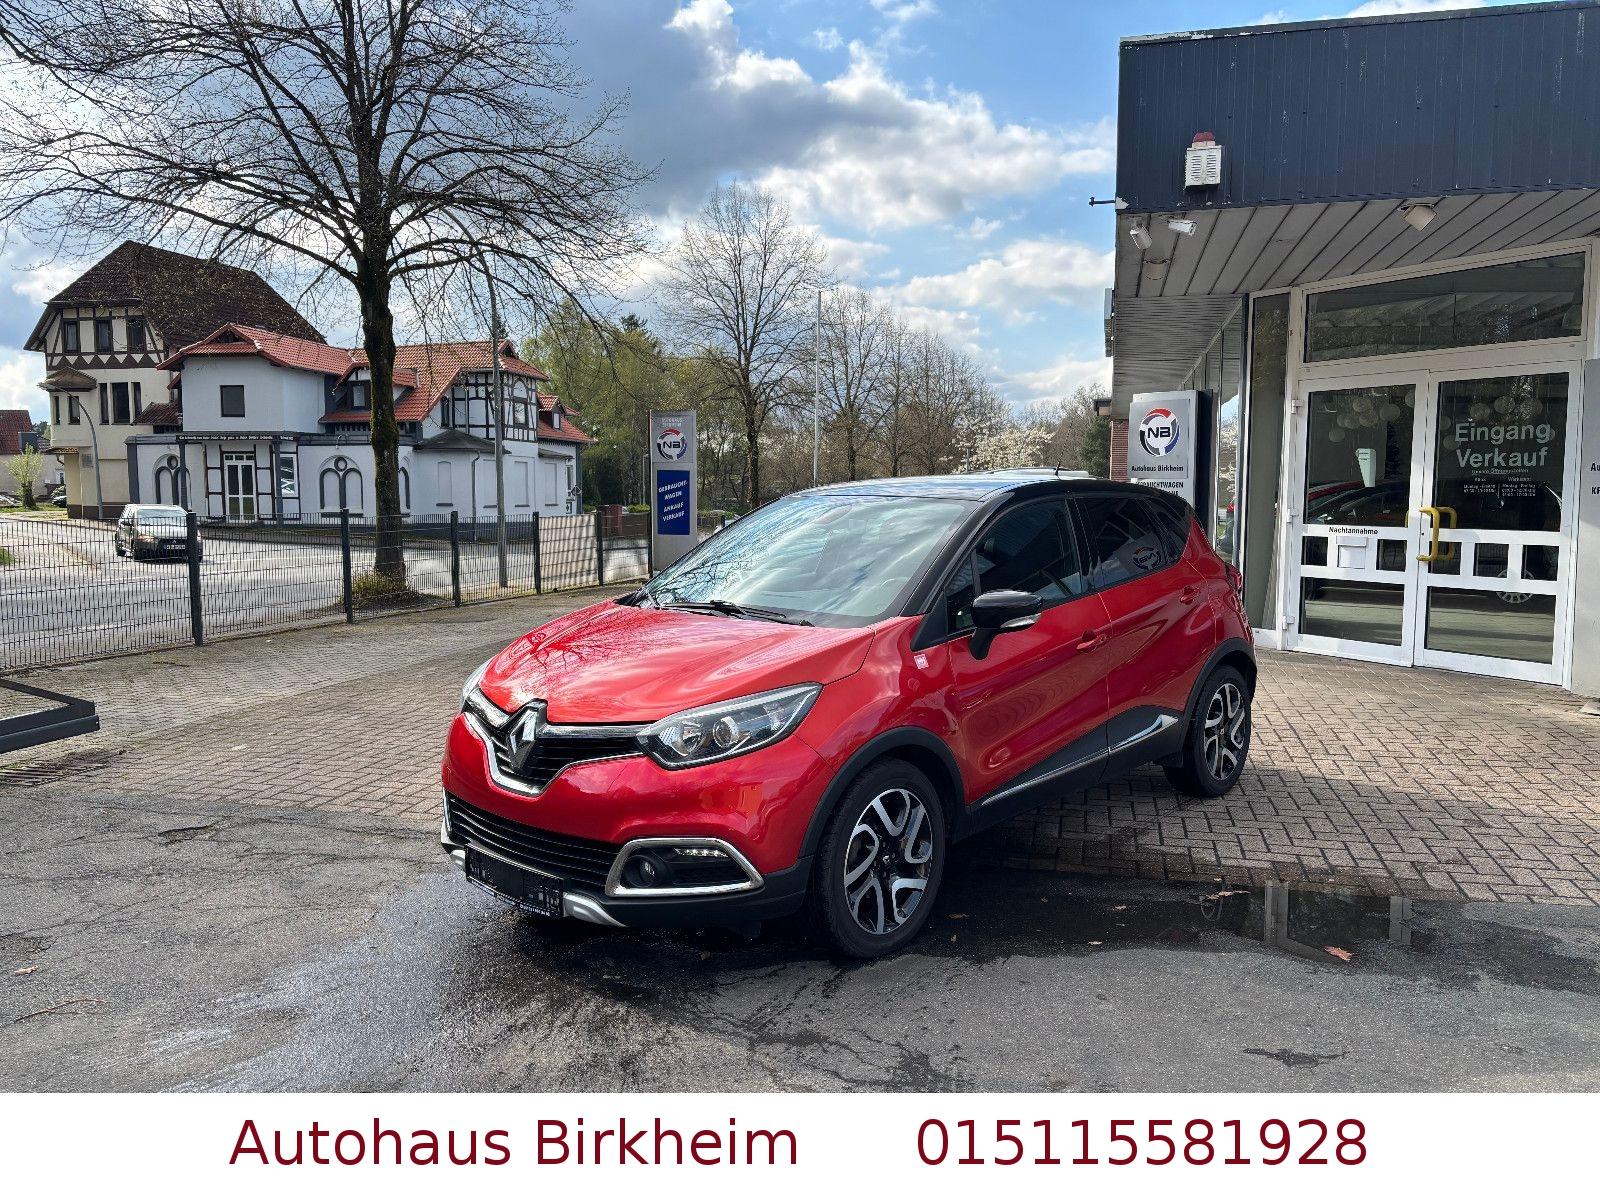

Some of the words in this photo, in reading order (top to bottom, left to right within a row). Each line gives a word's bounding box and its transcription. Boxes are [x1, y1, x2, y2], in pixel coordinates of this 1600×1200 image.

[1147, 426, 1171, 438] NB
[1455, 423, 1551, 445] Eingang
[1456, 447, 1549, 468] Verkauf
[1328, 526, 1378, 535] Nachtannahme
